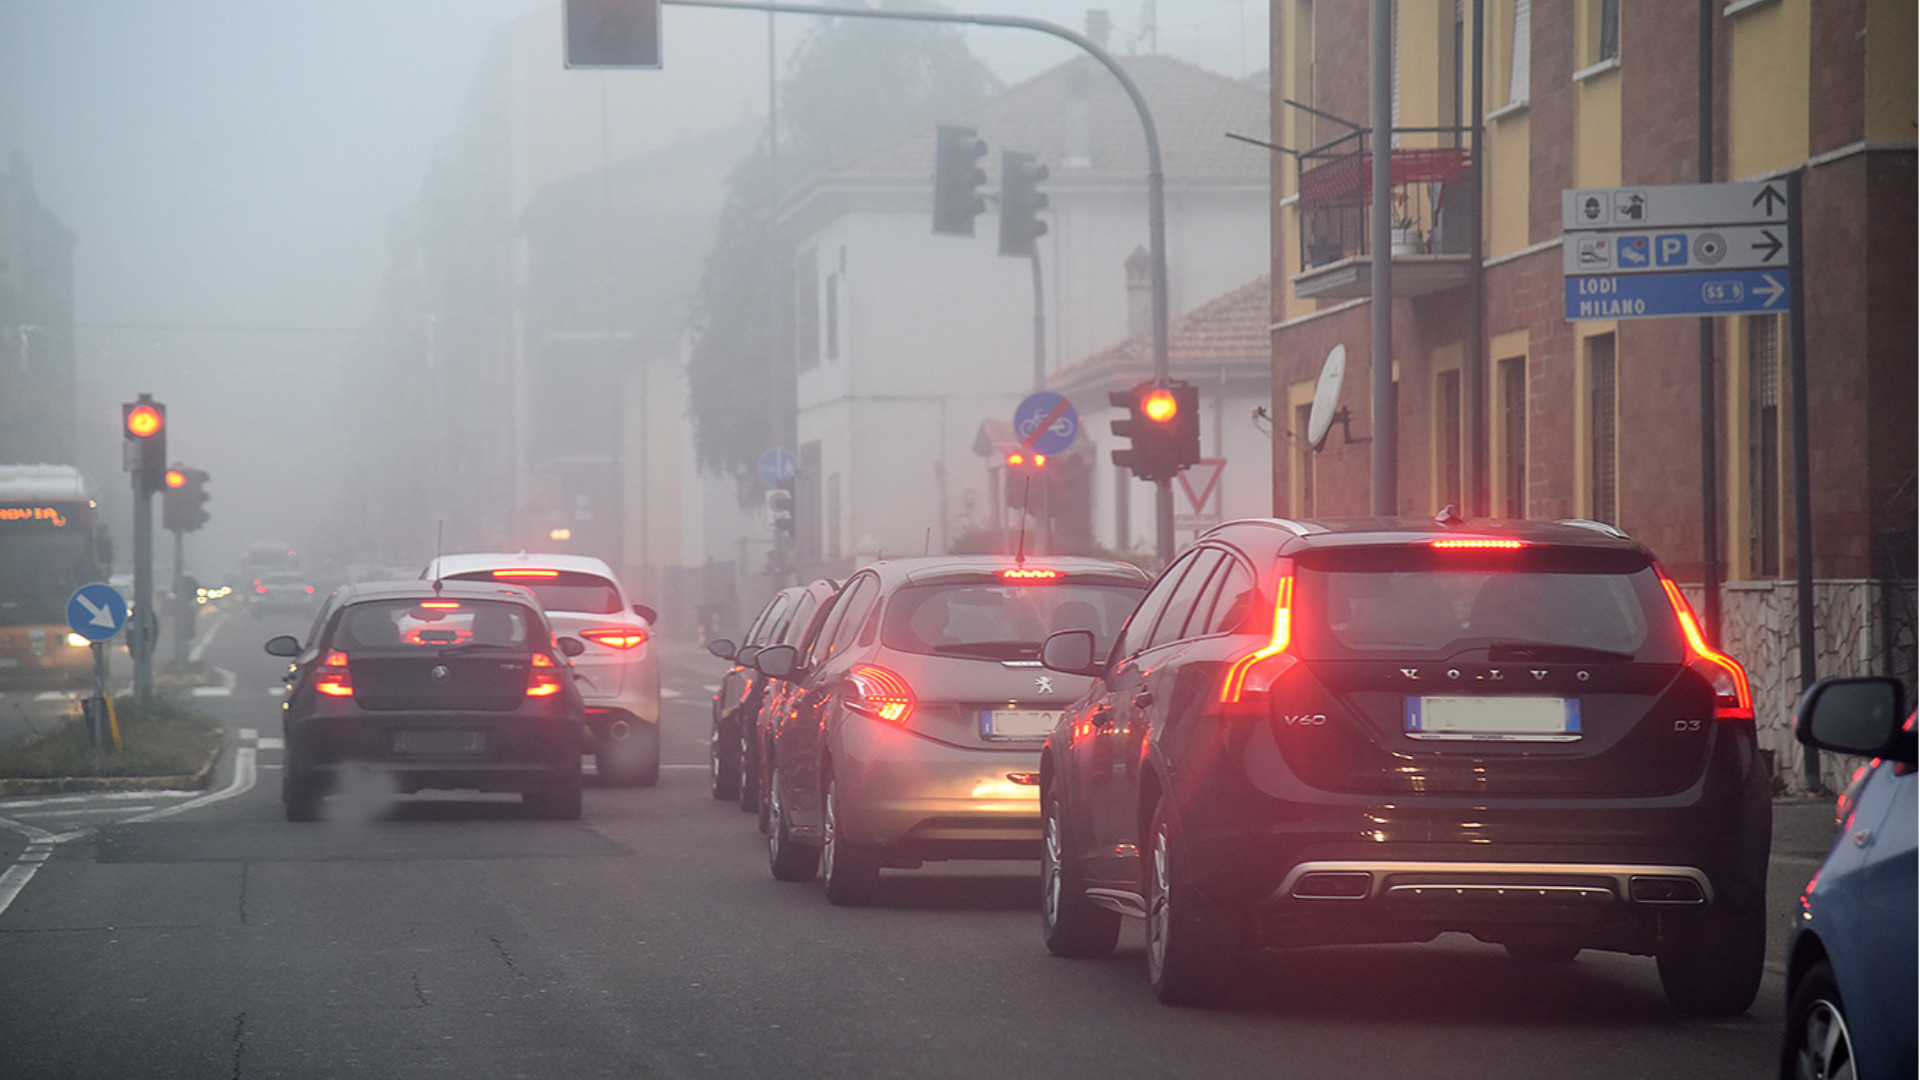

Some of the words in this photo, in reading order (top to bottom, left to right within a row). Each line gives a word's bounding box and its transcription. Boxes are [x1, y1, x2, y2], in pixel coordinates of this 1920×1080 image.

[1661, 238, 1681, 263] P
[1579, 278, 1617, 295] LODI
[1706, 285, 1724, 299] SS
[1732, 284, 1741, 298] 9
[1580, 298, 1645, 316] MILANO
[1400, 668, 1590, 681] VOLVO
[1284, 714, 1326, 726] V60
[1674, 720, 1701, 731] D3
